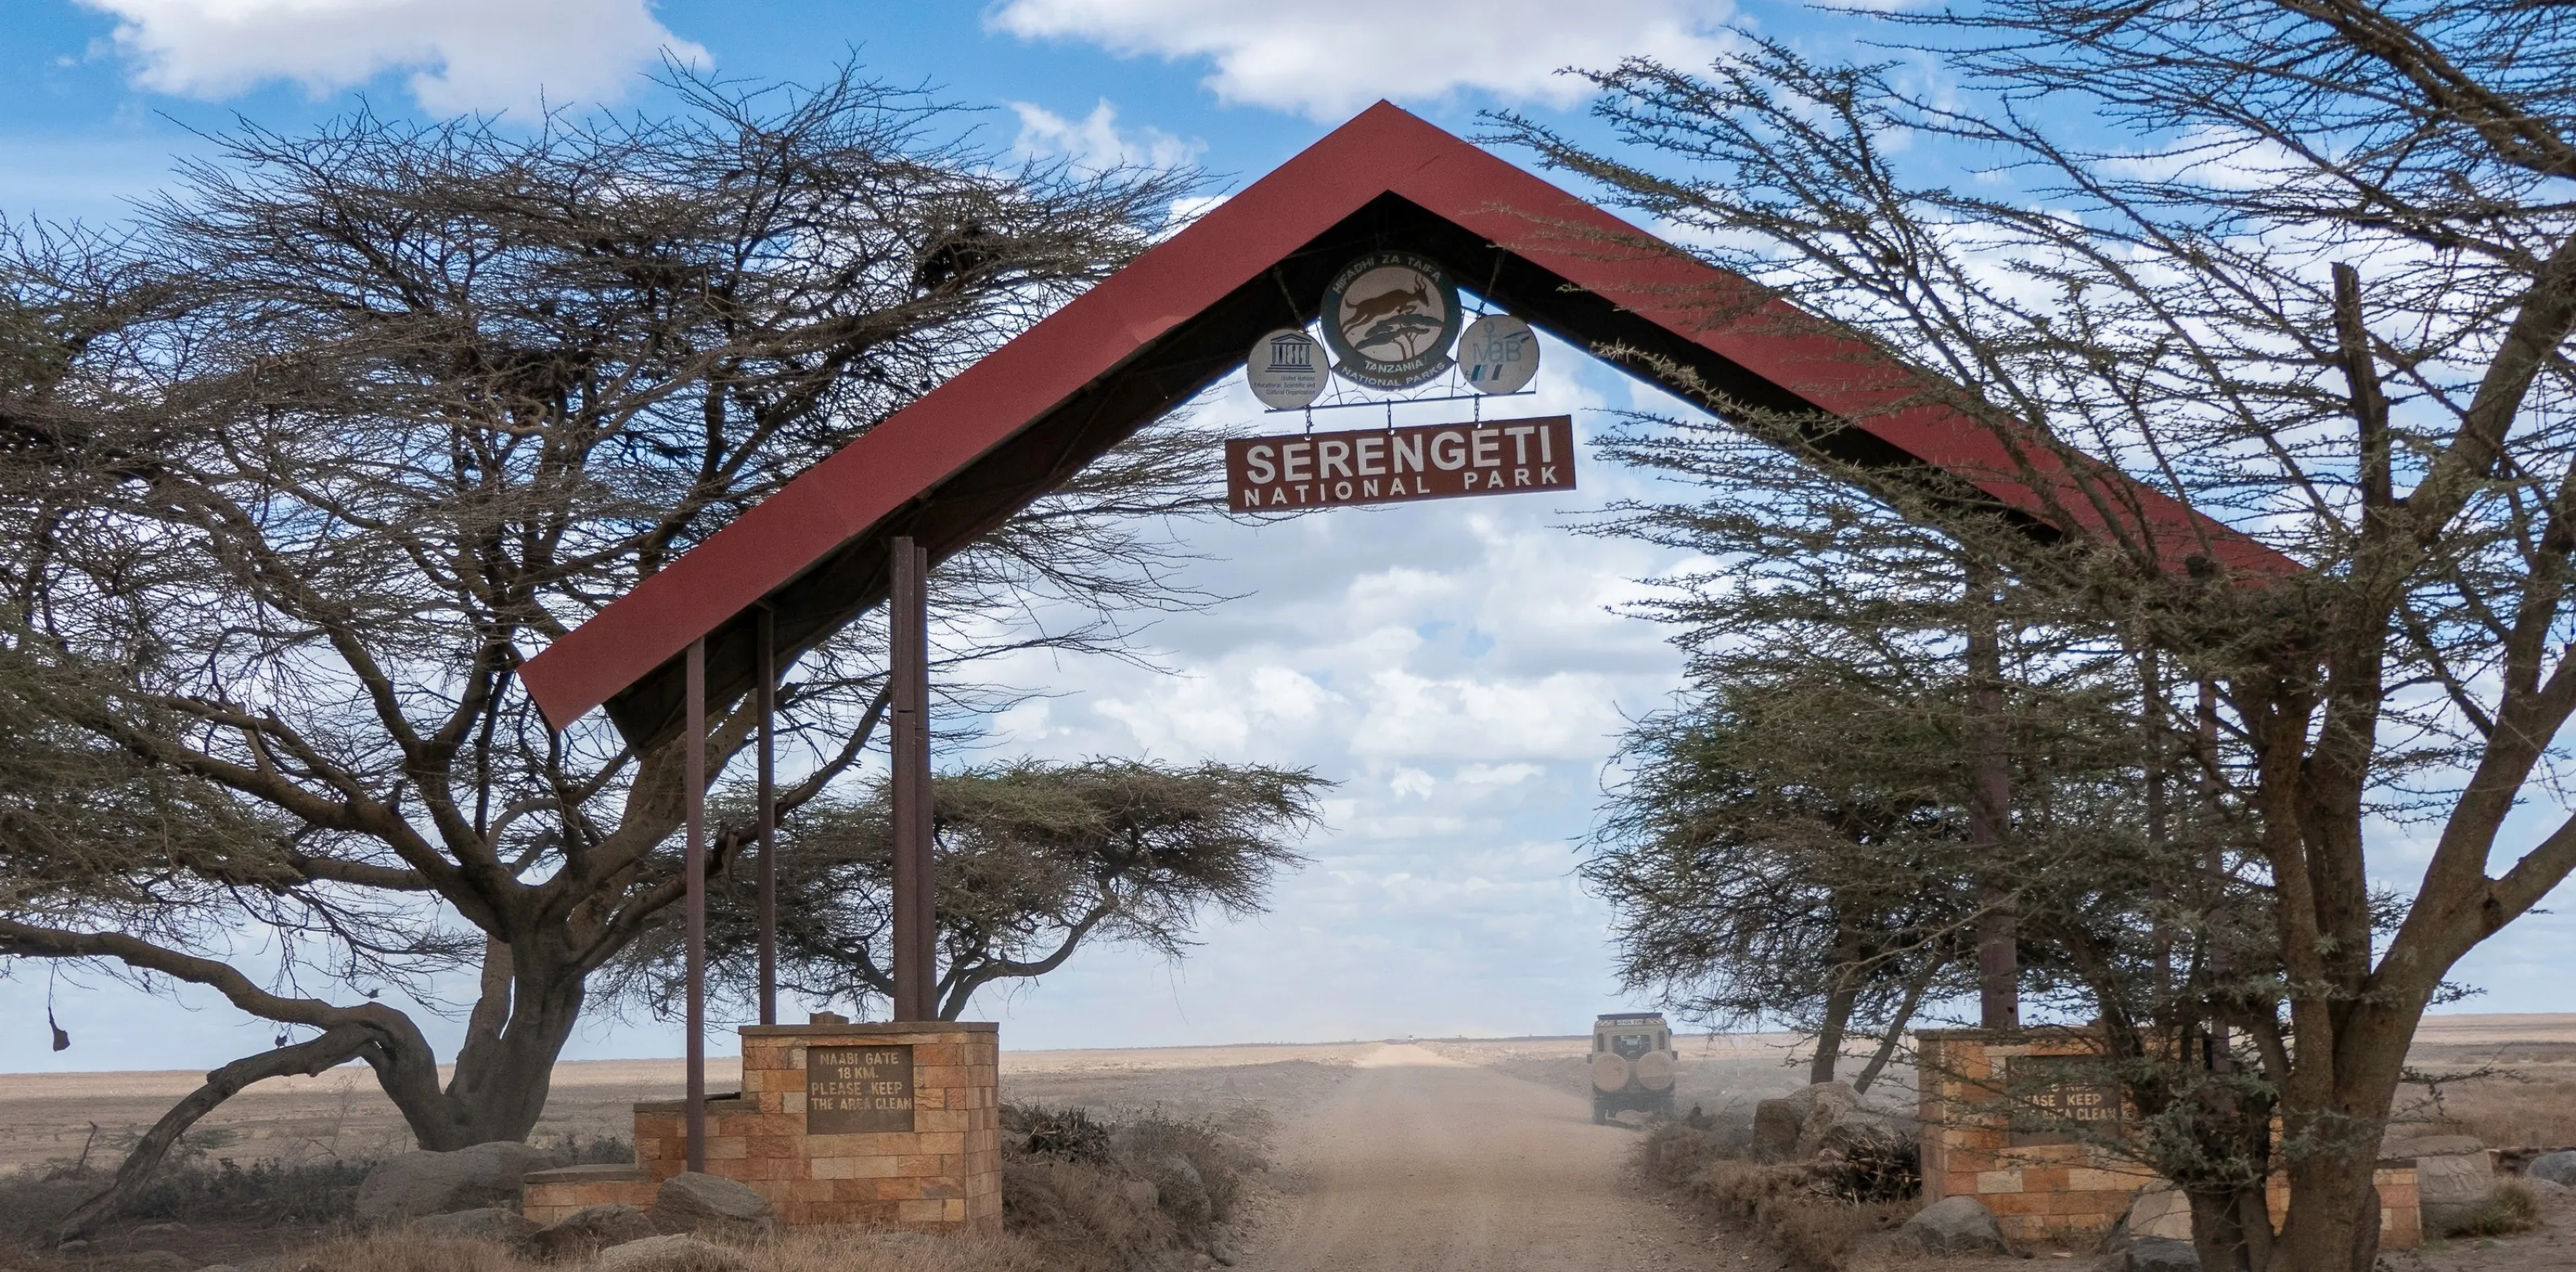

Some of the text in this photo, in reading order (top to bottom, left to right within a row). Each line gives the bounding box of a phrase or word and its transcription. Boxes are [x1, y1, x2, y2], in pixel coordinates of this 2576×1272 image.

[1332, 254, 1442, 295] HIFADHI ZA TAIFA
[1272, 344, 1311, 365] UNESCO
[1341, 366, 1402, 387] NATIONAL
[1406, 361, 1446, 385] PARKS
[1364, 359, 1425, 374] TANZANIA
[1246, 425, 1552, 485] SERENGETI
[1244, 465, 1558, 507] NATIONAL PARK
[819, 1052, 899, 1066] NAABI GATE
[838, 1067, 852, 1080] 18
[811, 1081, 903, 1096] PLEASE KEEP
[811, 1097, 913, 1110] THE AREA CLEAN
[2066, 1093, 2103, 1106] KEEP
[2076, 1107, 2117, 1121] CLEAN
